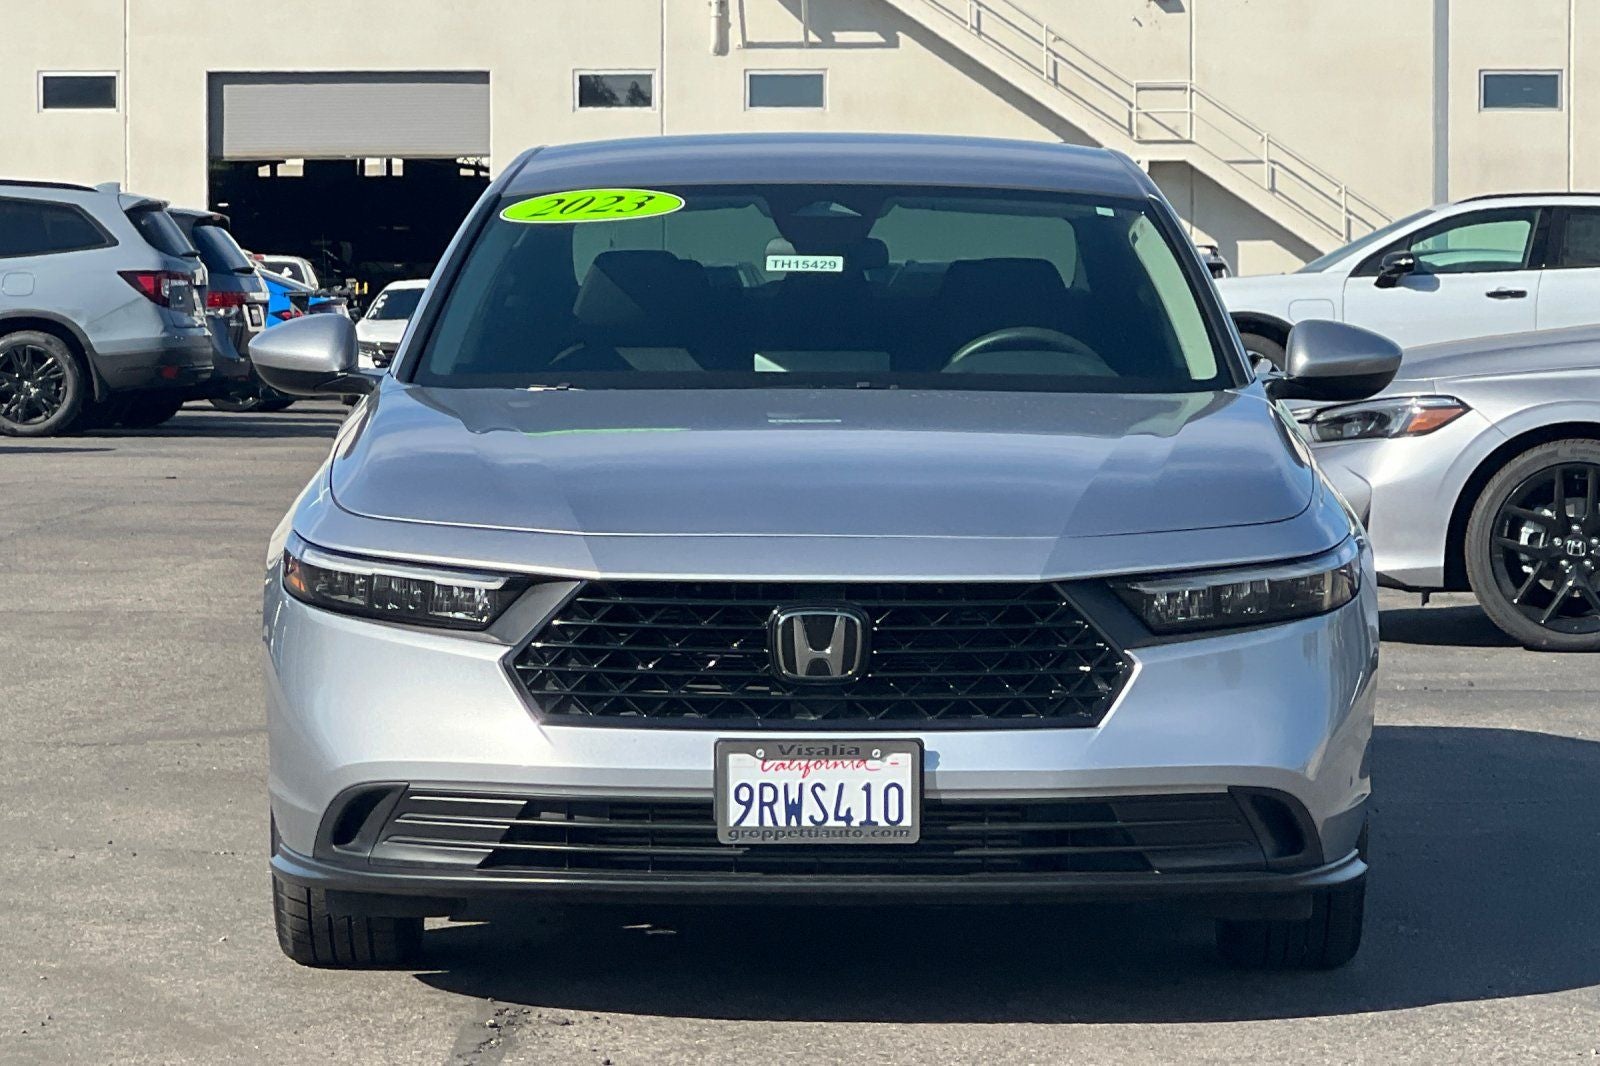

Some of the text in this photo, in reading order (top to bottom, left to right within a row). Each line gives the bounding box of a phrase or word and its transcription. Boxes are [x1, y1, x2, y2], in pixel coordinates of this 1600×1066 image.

[526, 195, 656, 218] 2023
[771, 259, 837, 270] TH15429
[777, 744, 861, 756] Visalia
[760, 758, 881, 779] California
[732, 782, 905, 827] 9RWS410
[727, 826, 911, 841] groppettiauto.com
